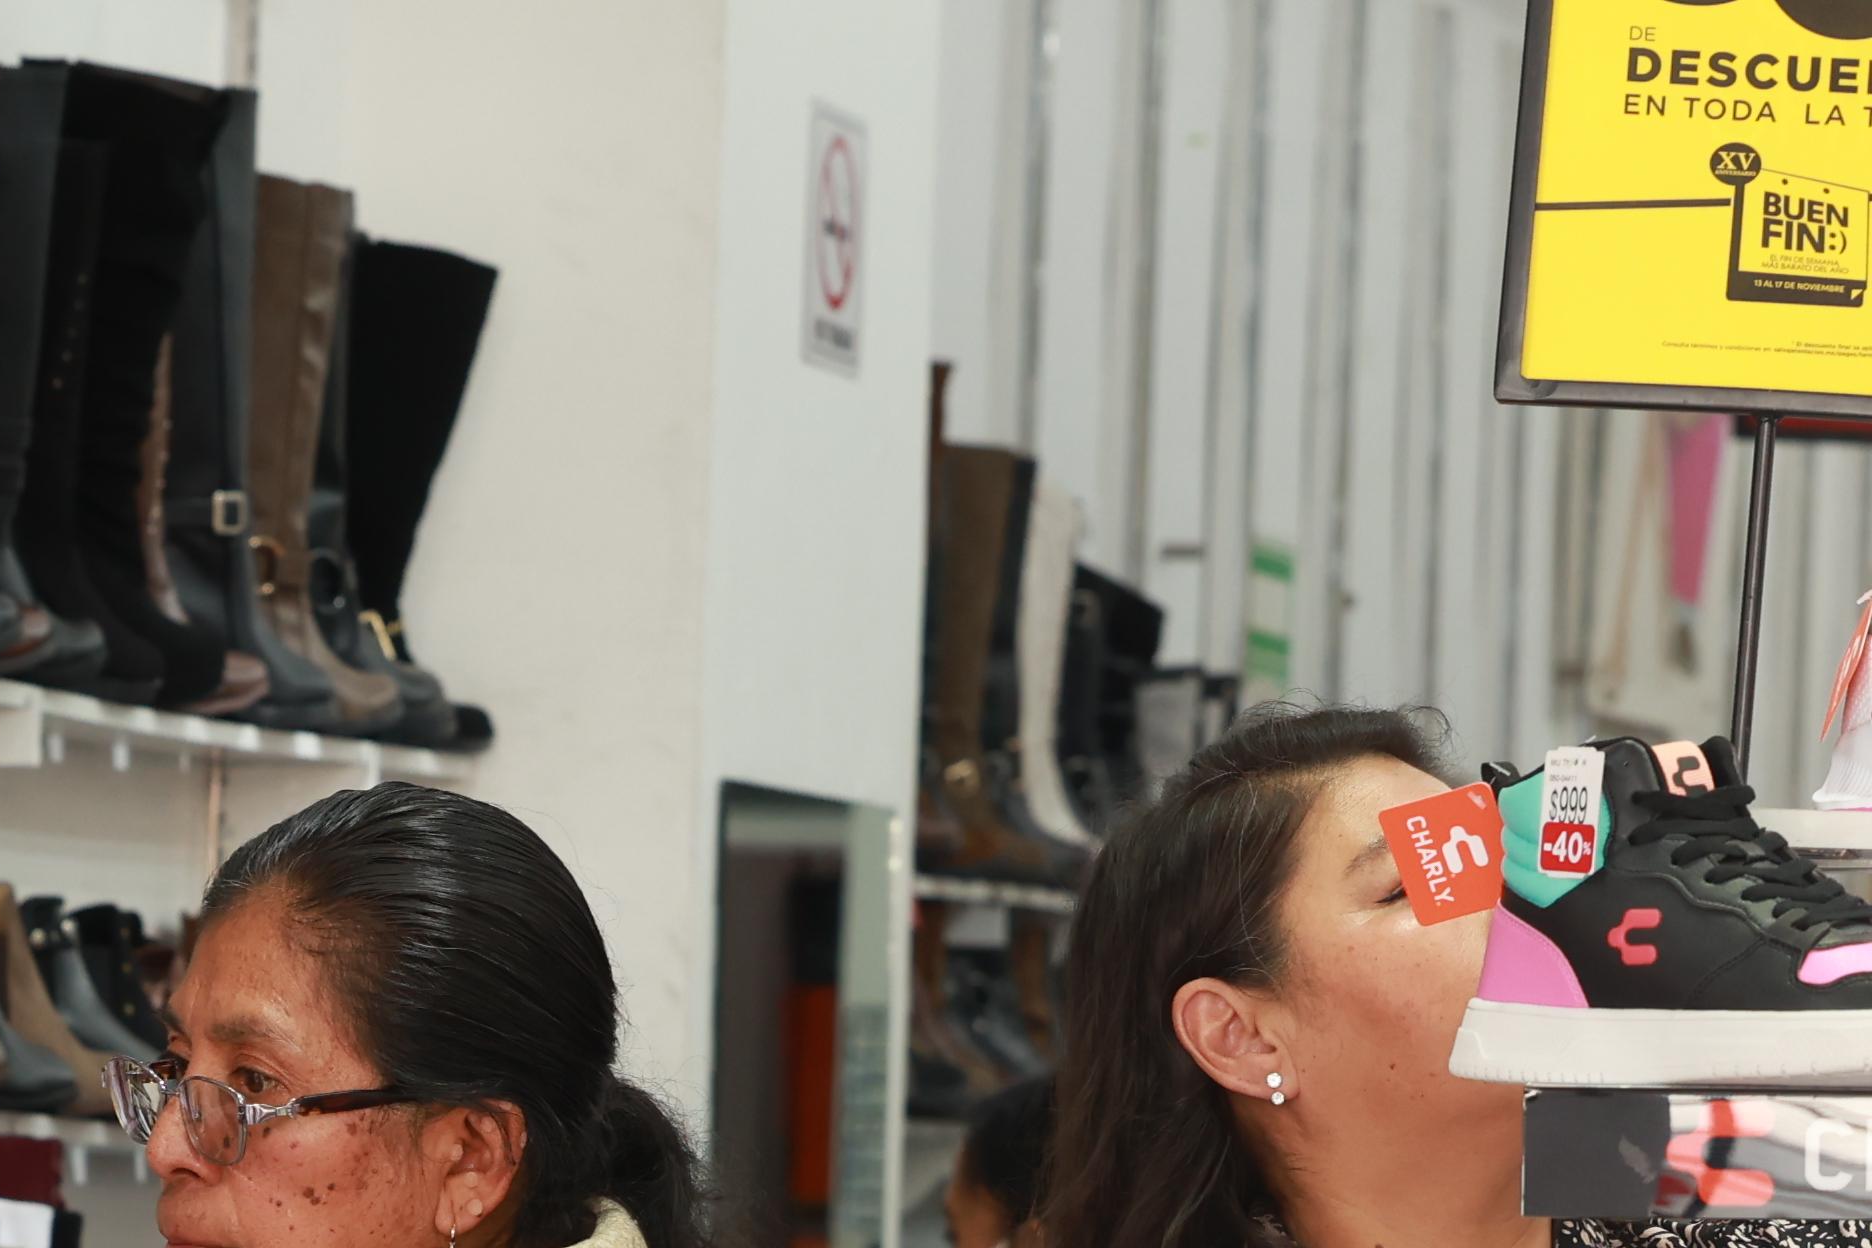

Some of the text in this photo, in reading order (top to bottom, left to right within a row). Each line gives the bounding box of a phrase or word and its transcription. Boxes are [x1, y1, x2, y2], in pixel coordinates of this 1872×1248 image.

[1629, 26, 1657, 42] DE
[1626, 47, 1872, 95] DESCUE
[1624, 94, 1667, 116] EN
[1683, 97, 1777, 122] TODA
[1805, 104, 1846, 126] LA
[1716, 151, 1756, 170] XV
[1763, 191, 1849, 228] BUEN
[1549, 786, 1588, 825] $999
[1406, 815, 1455, 903] CHARLY
[1542, 830, 1593, 865] -40%
[1804, 1118, 1872, 1193] C
